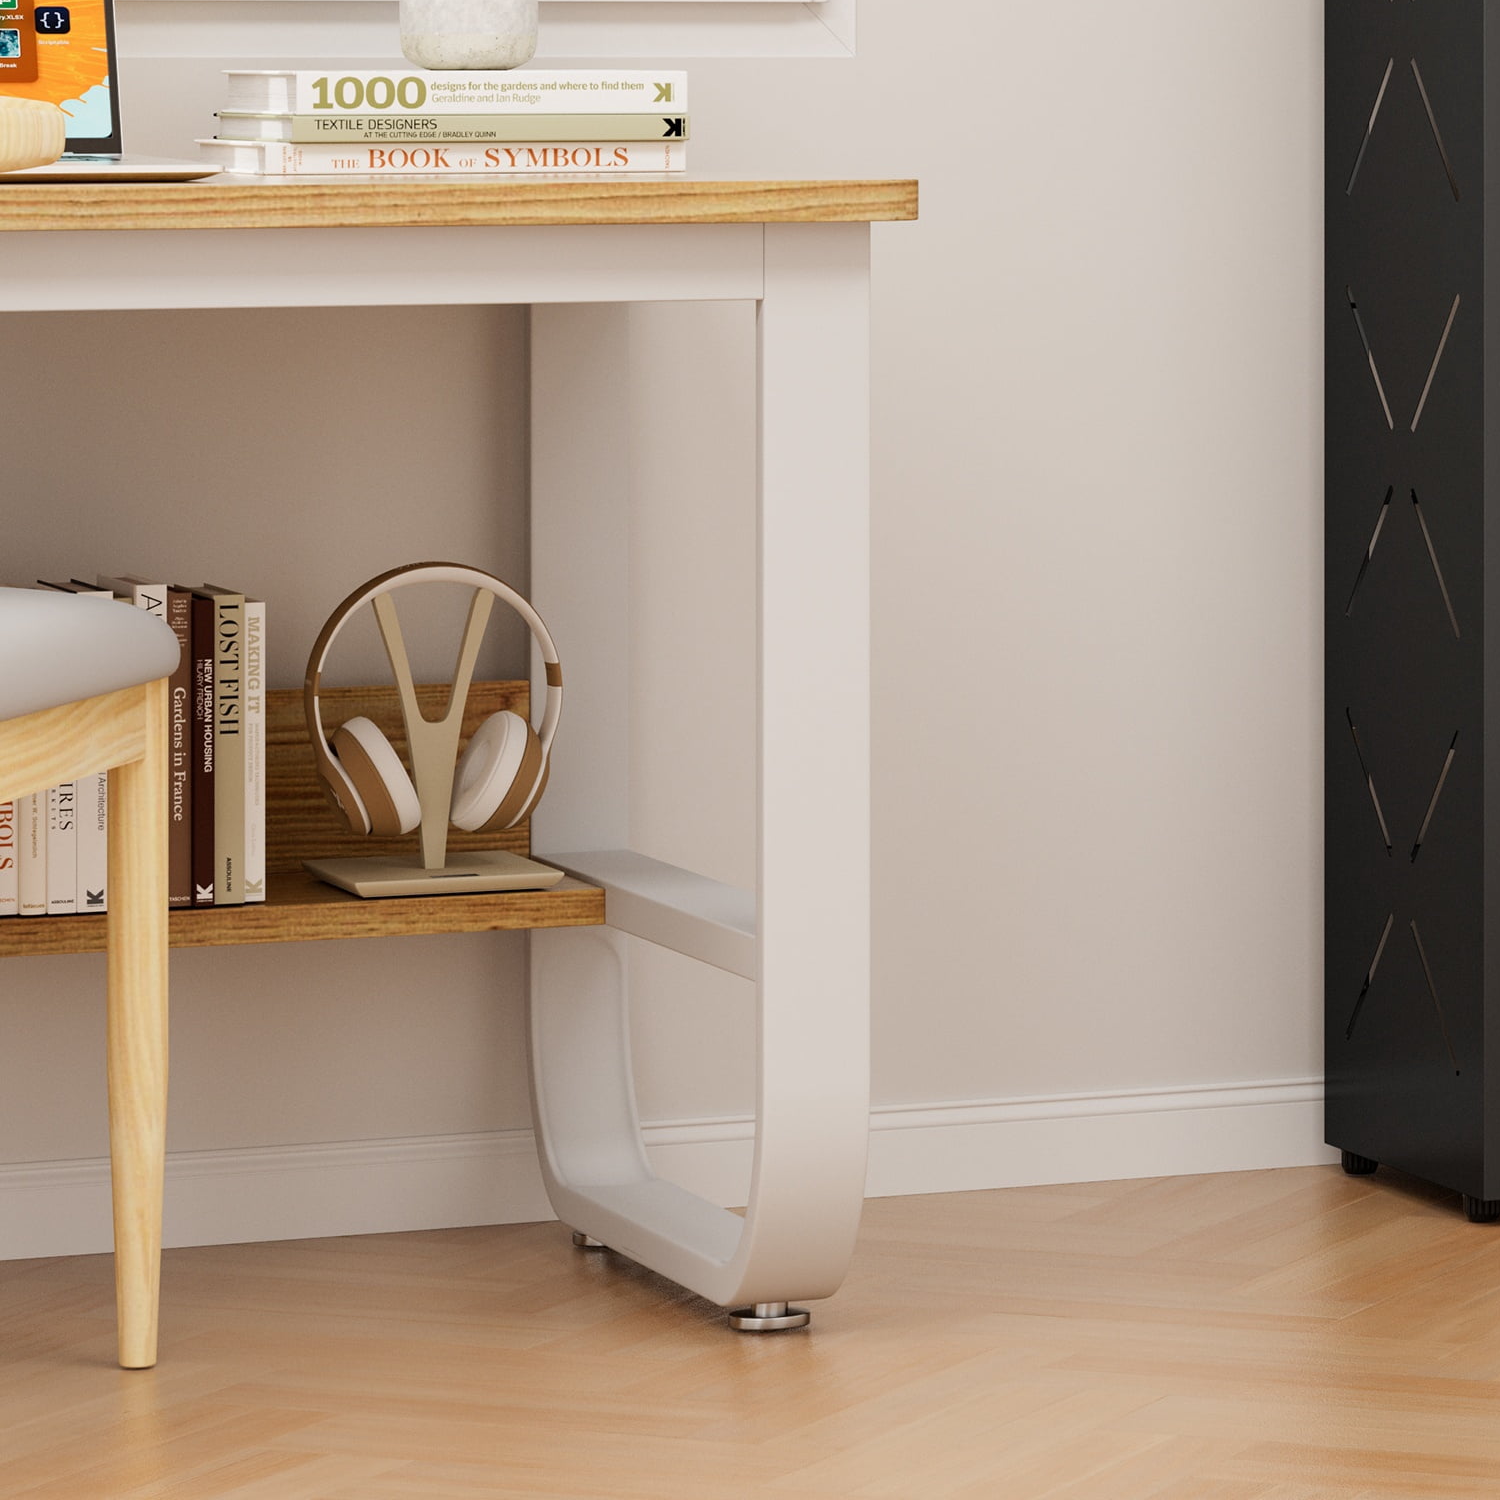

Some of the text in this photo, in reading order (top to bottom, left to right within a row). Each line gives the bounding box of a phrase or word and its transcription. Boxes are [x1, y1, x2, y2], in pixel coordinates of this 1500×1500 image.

[311, 76, 427, 110] 1000
[430, 80, 645, 93] designs for the gardens and where to find them
[431, 93, 541, 105] Geraldine and Ian Rudge
[314, 118, 438, 130] TEXTILE DESIGNERS
[331, 146, 629, 169] THE BOOK OF SYMBOLS
[219, 604, 239, 735] LOST FISH
[247, 616, 260, 714] MAKING IT
[204, 659, 213, 773] NEW URBAN HOUSING
[173, 687, 187, 822] Gardens in France
[97, 777, 106, 831] Architecture
